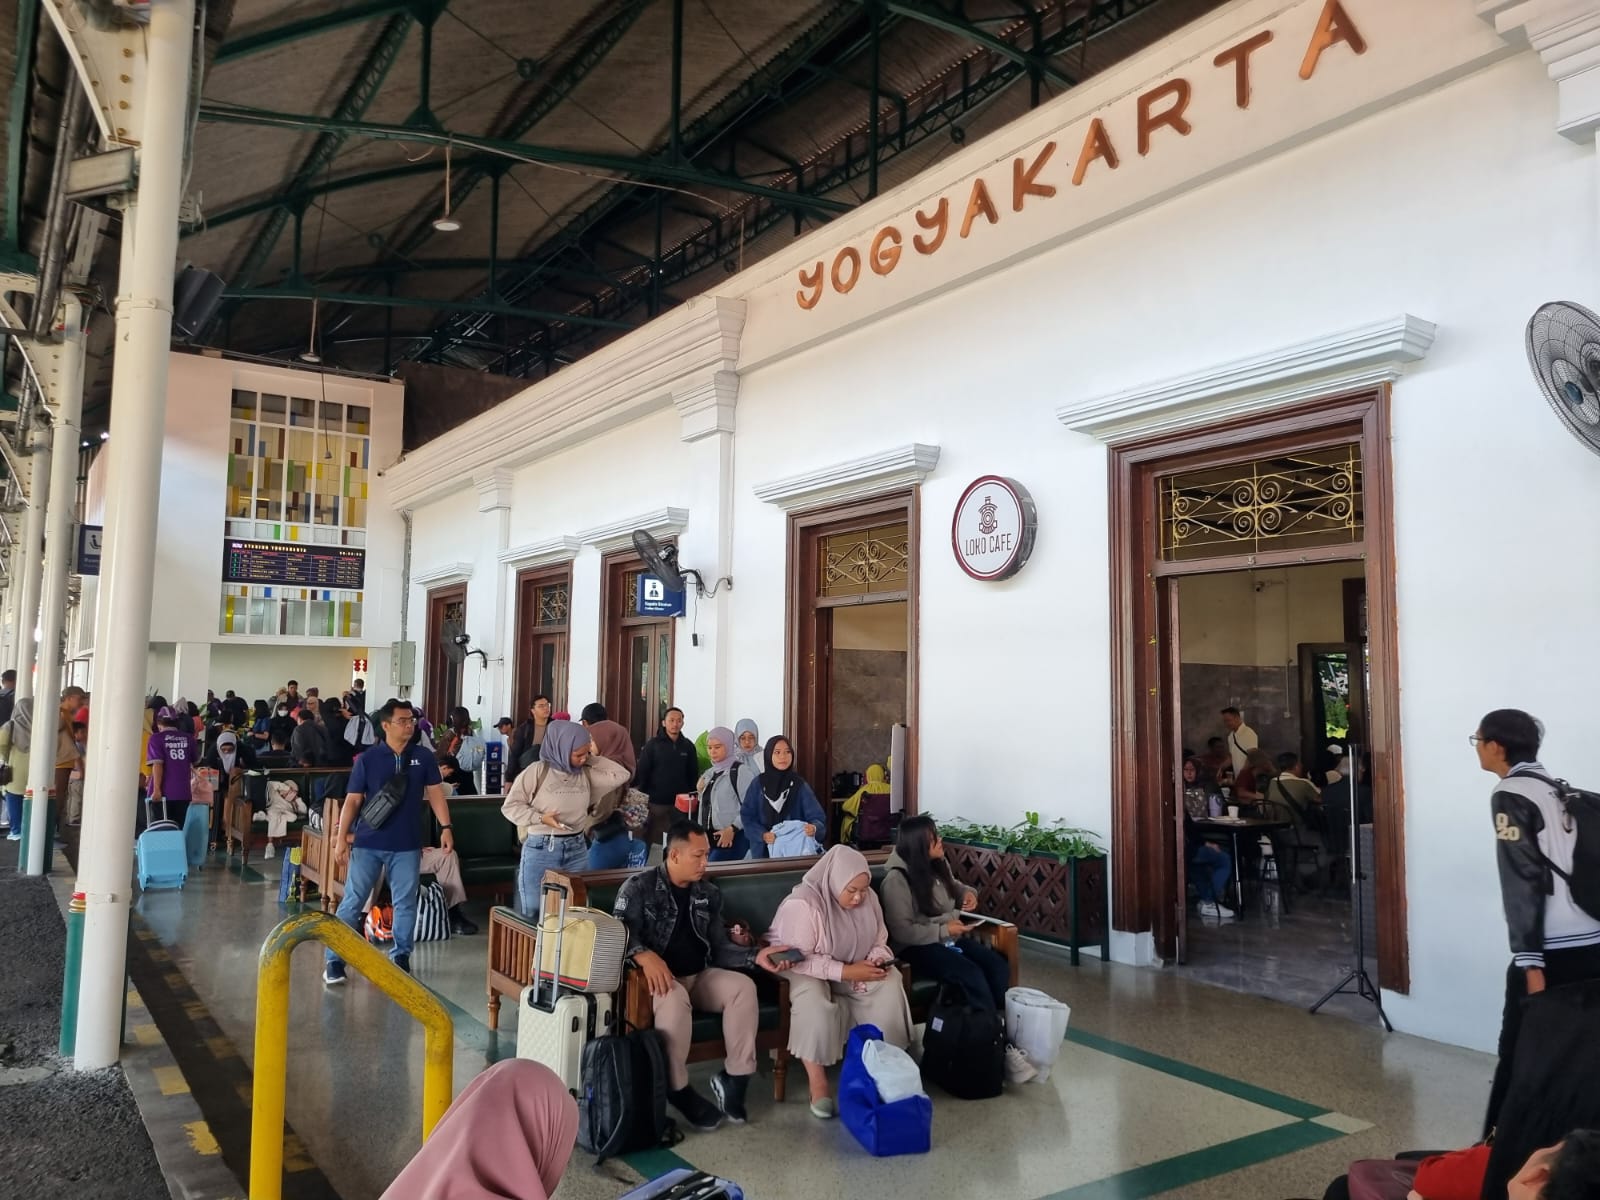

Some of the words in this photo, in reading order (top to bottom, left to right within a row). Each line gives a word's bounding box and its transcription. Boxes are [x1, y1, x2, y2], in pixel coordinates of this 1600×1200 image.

[797, 0, 1367, 309] YOGYAKARTA
[965, 537, 987, 556] LOKO
[989, 533, 1012, 553] CAFE
[170, 749, 185, 760] 68
